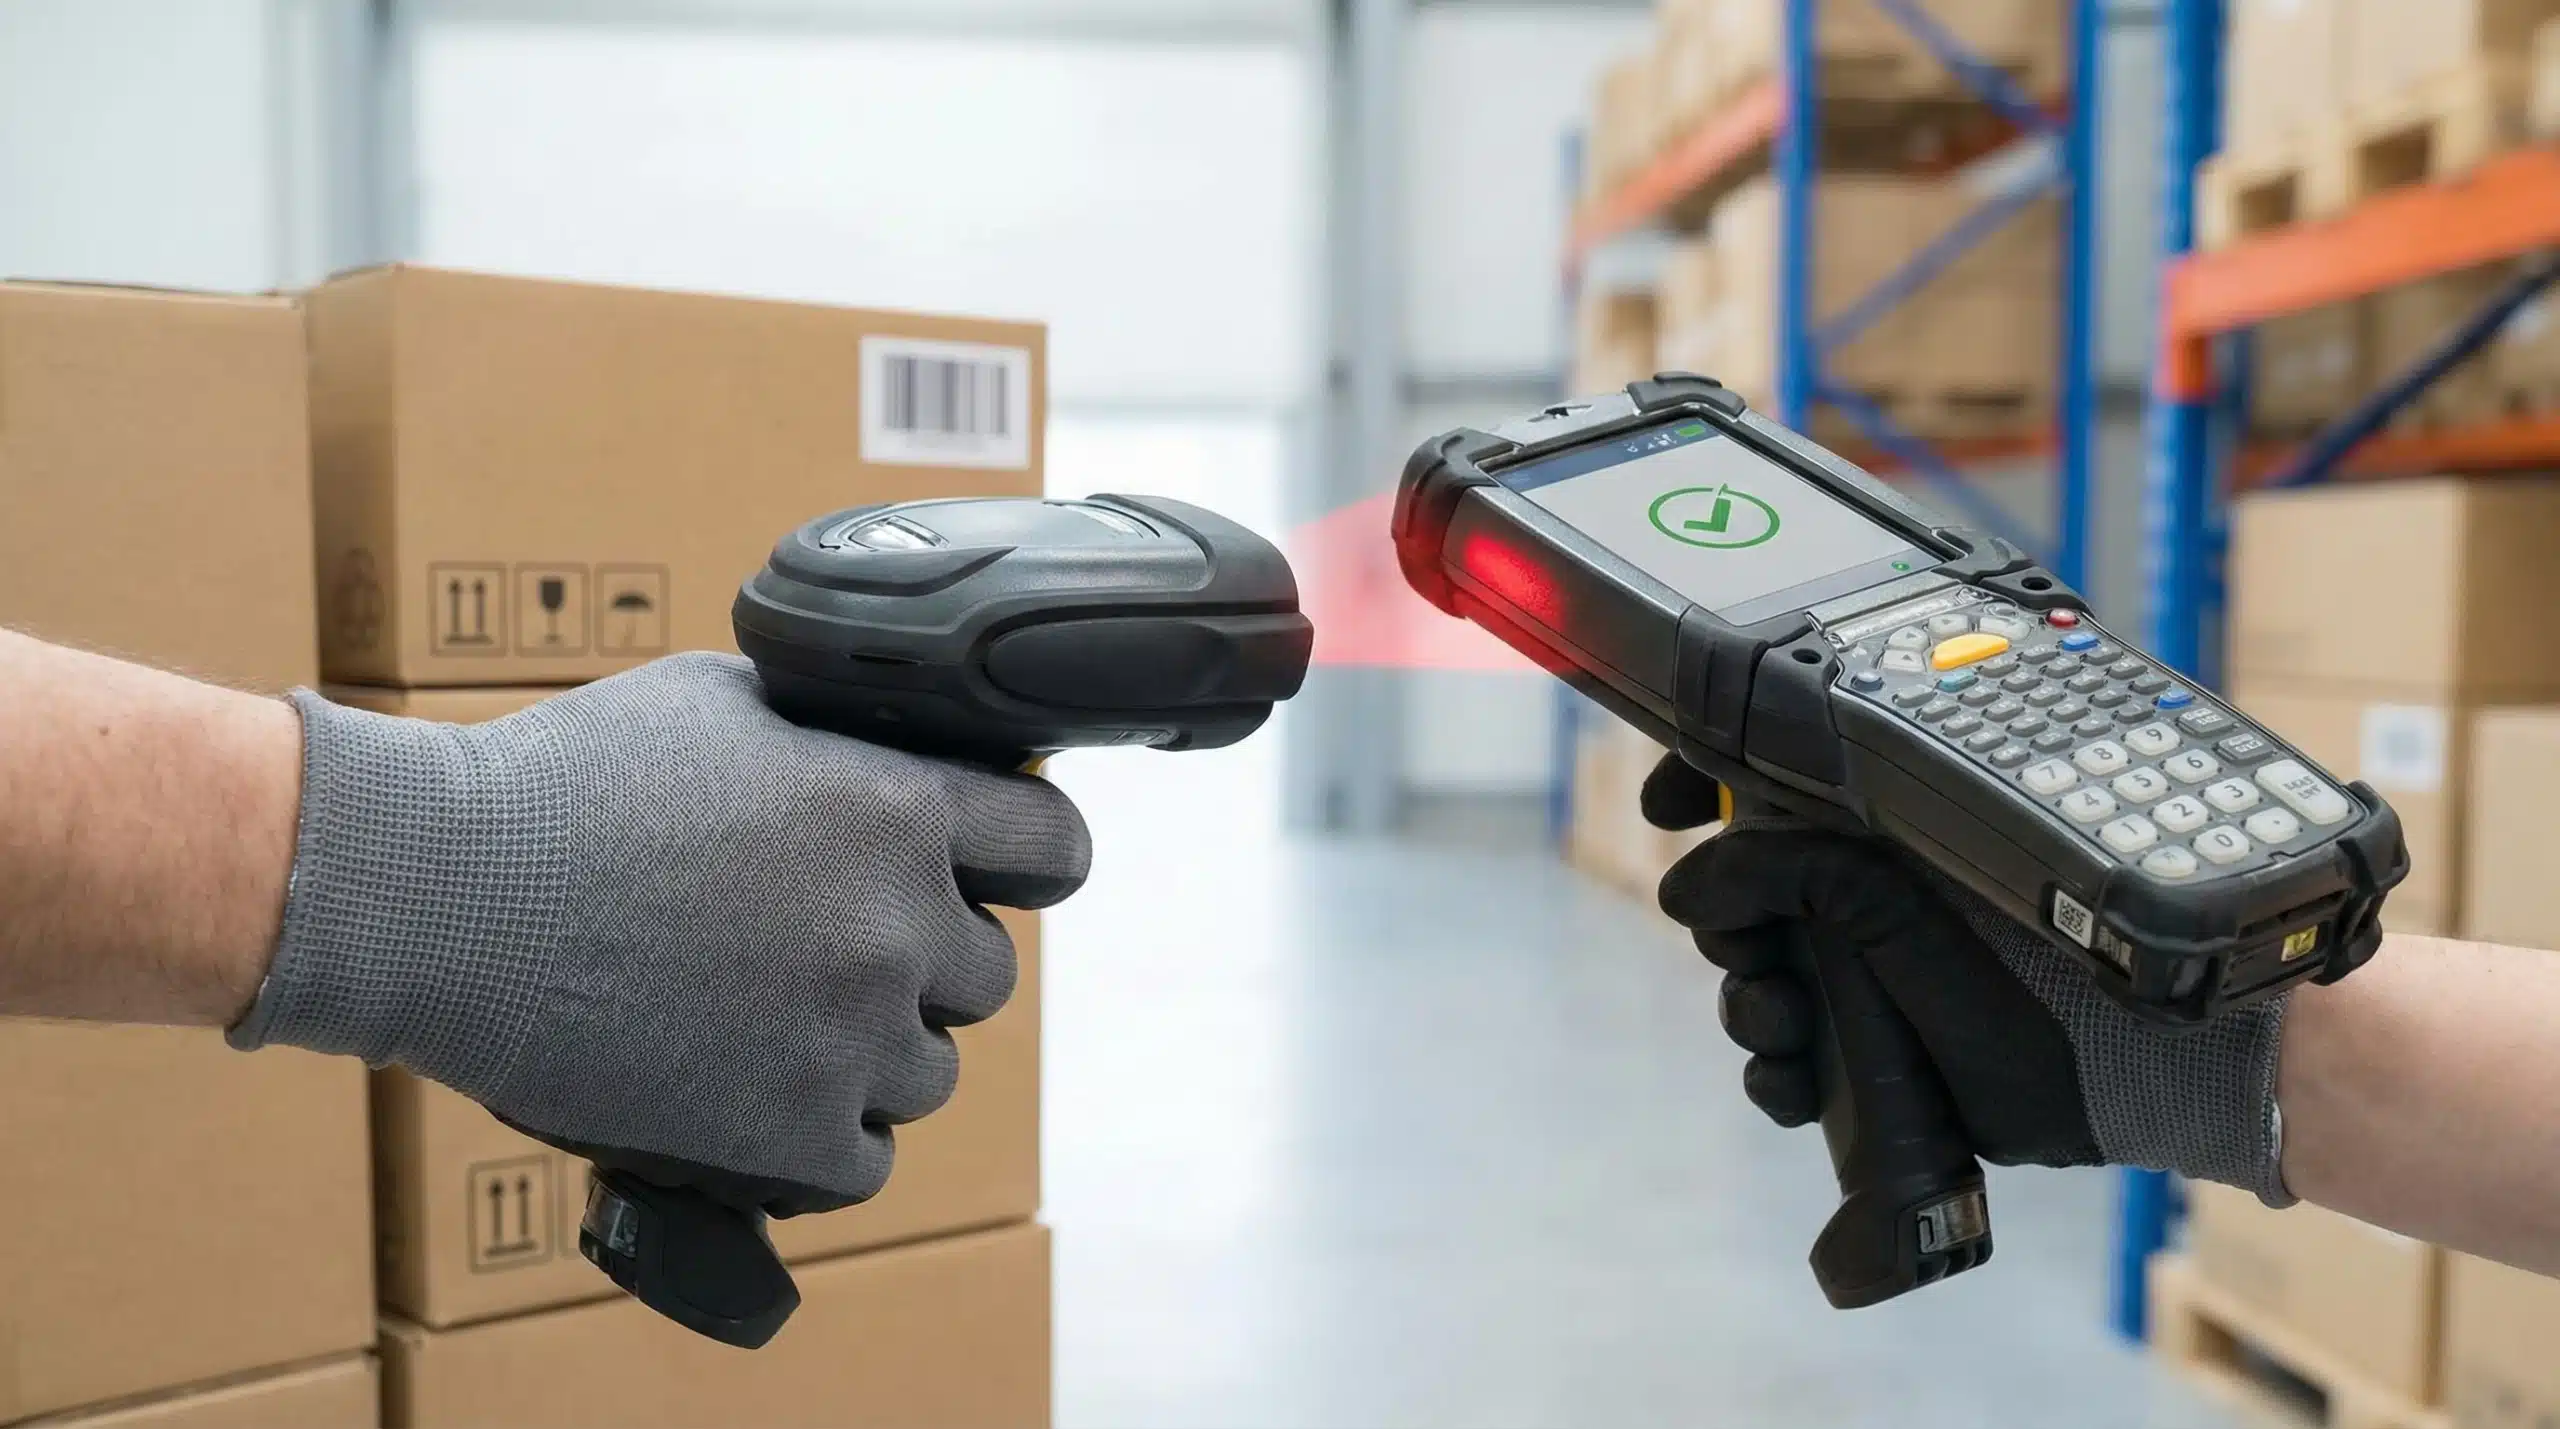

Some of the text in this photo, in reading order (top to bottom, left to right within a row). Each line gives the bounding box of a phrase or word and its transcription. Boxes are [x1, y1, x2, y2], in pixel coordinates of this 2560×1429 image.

[2146, 728, 2162, 741] 9
[2093, 747, 2113, 760] 8
[2187, 756, 2203, 769] 6
[2039, 764, 2056, 780] 7
[2132, 774, 2152, 788] 5
[2224, 784, 2244, 798] 3
[2082, 792, 2101, 806] 4
[2172, 803, 2195, 817] 2
[2121, 822, 2139, 836] 1
[2215, 834, 2233, 847] 0
